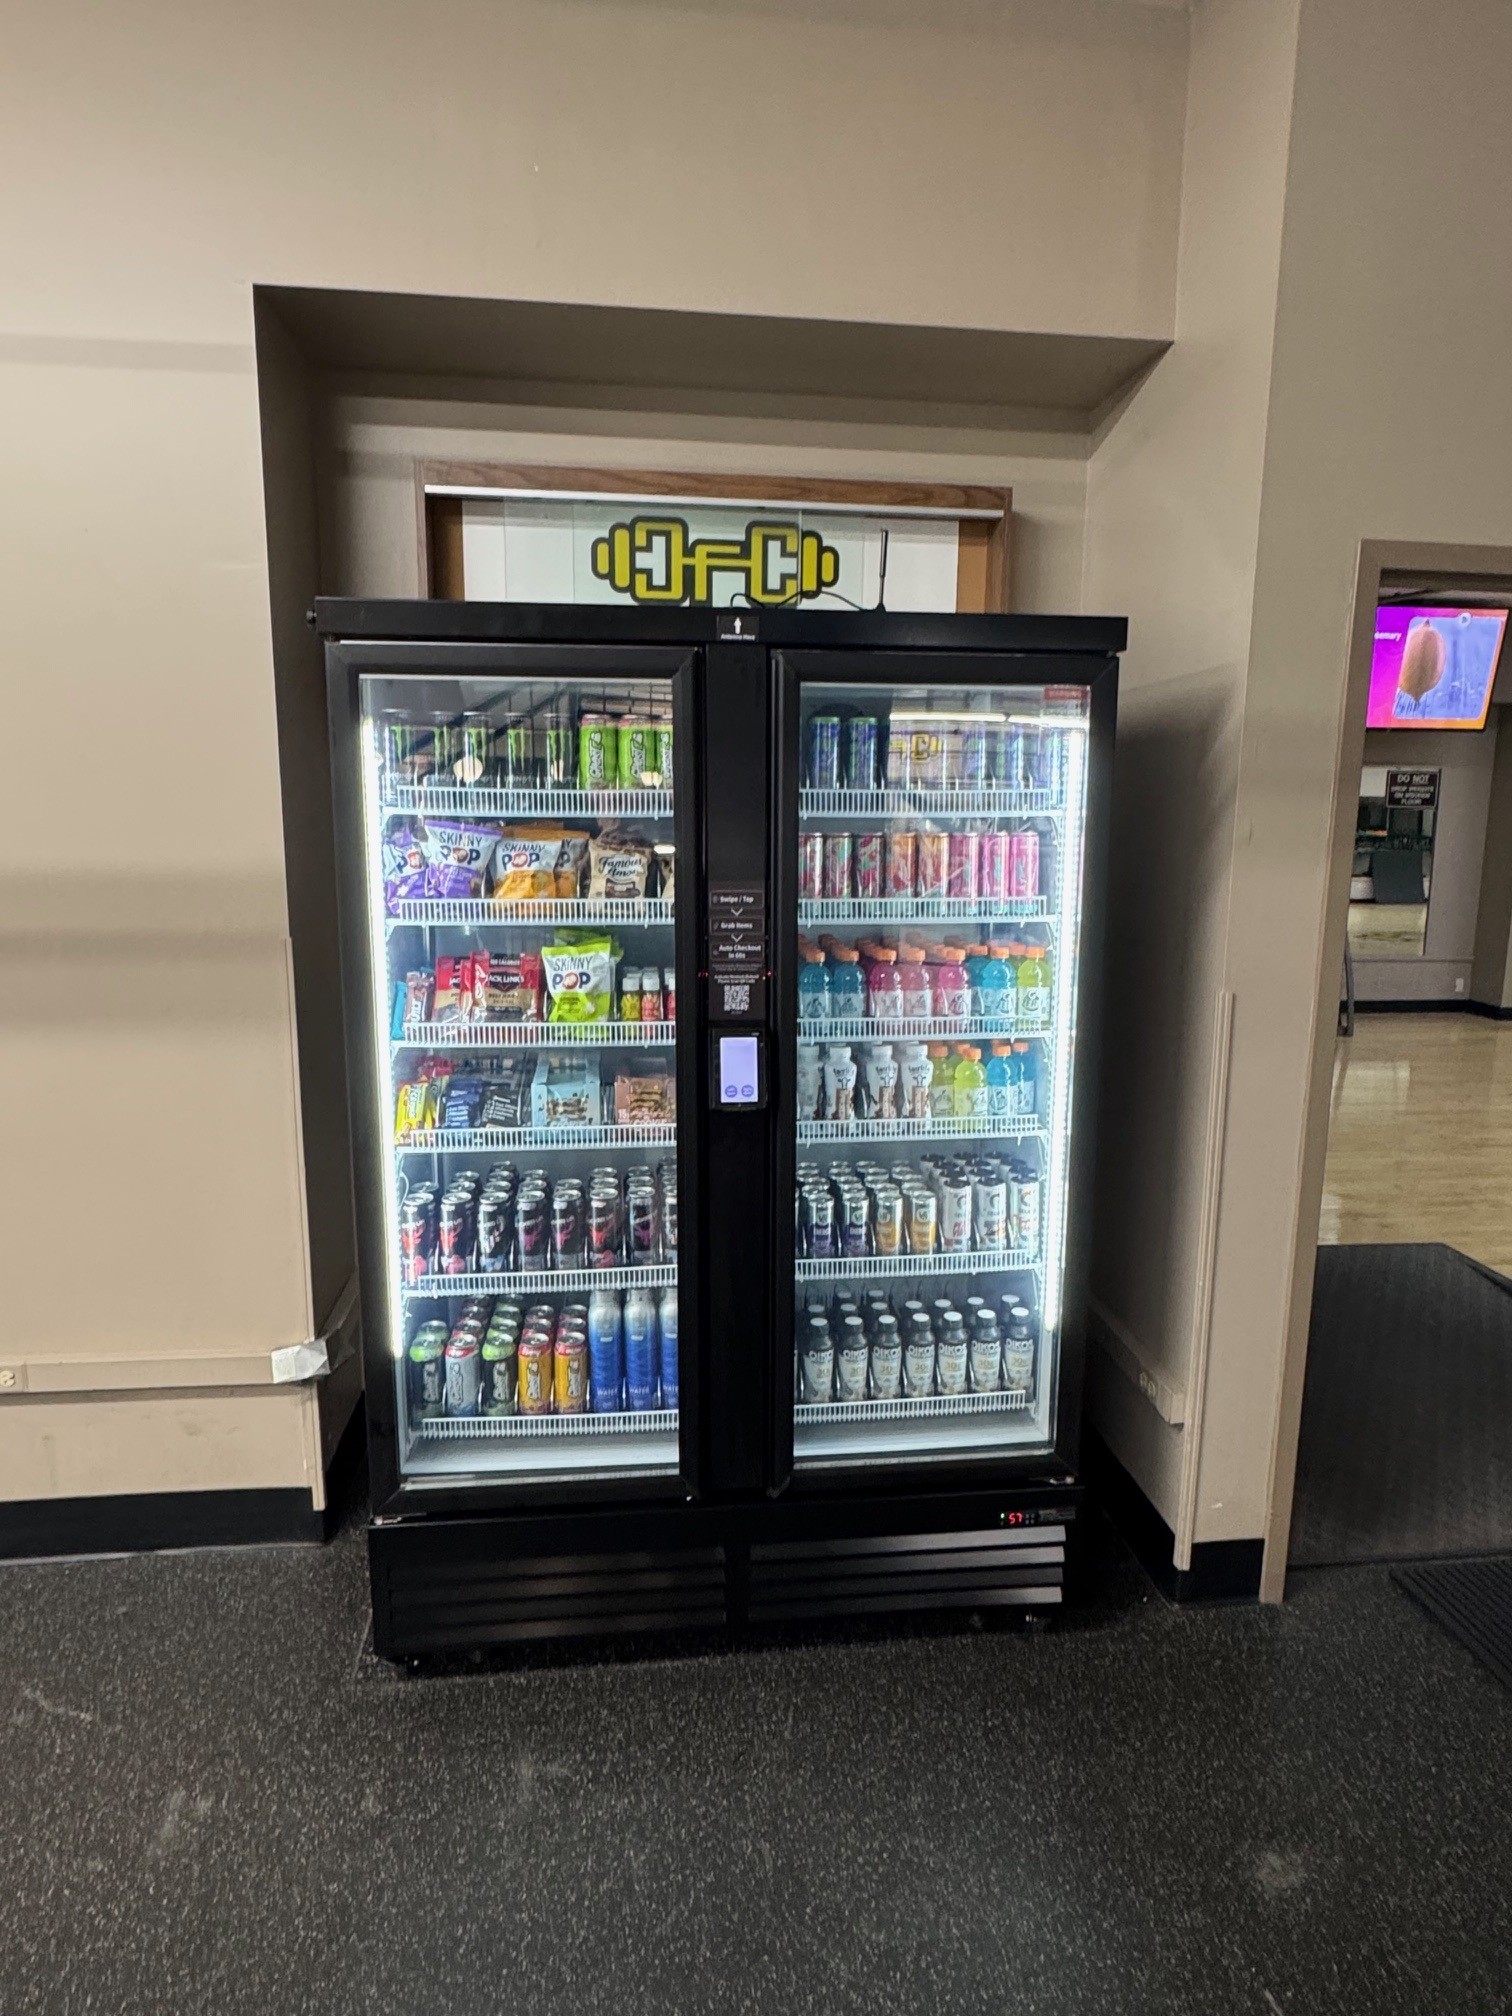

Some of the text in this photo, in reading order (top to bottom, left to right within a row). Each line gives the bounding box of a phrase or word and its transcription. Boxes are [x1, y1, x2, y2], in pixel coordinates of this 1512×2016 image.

[1397, 774, 1430, 784] DO NOT
[440, 830, 483, 848] SKINNY
[502, 852, 540, 871] POP
[720, 895, 738, 904] Swipe
[743, 895, 754, 904] Tap
[554, 956, 593, 971] SKINNY
[552, 971, 591, 991] POP
[1008, 1511, 1023, 1525] 57
